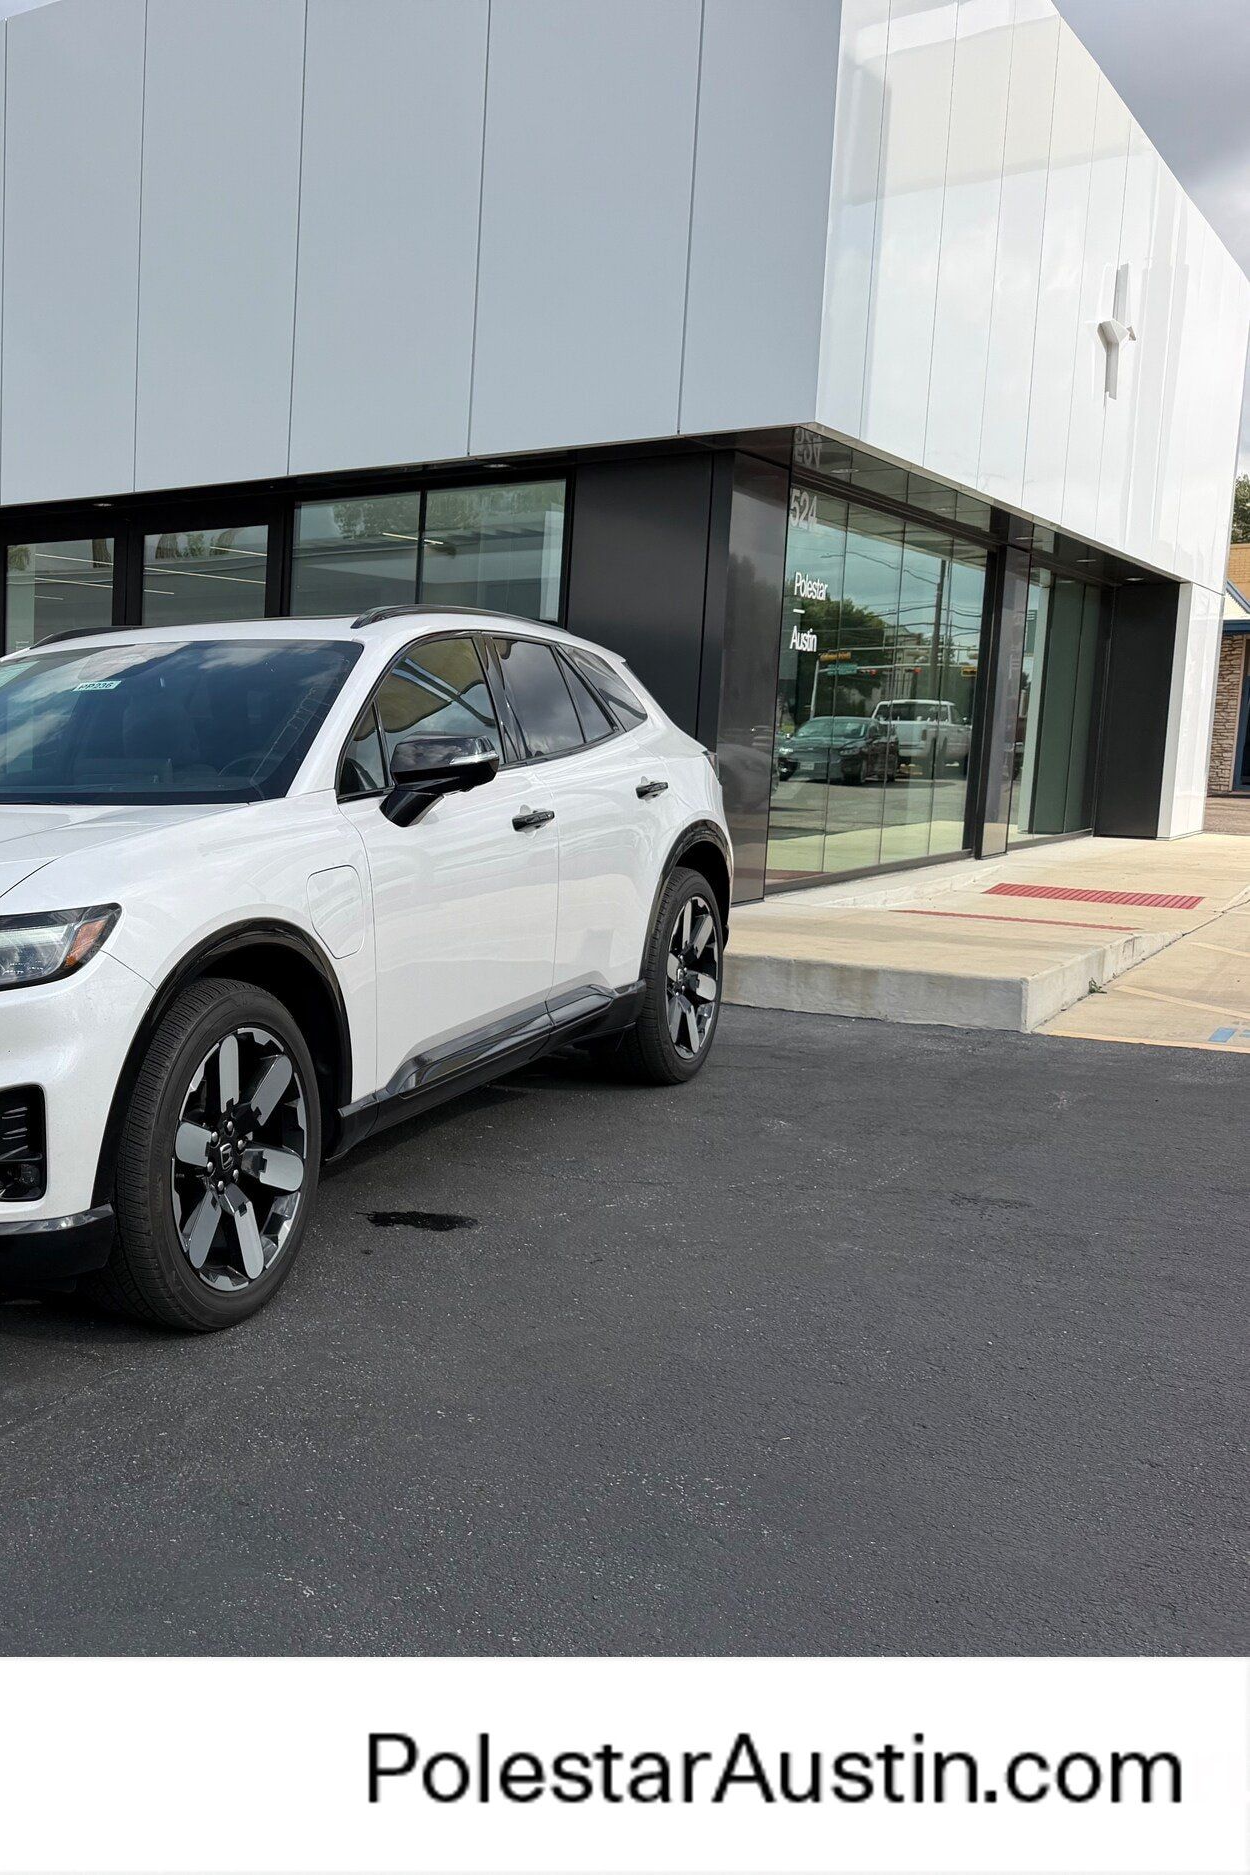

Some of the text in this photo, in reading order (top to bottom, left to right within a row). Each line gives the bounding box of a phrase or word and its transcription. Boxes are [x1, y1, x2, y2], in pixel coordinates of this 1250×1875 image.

[790, 489, 817, 531] 524
[794, 572, 828, 600] Polestar
[789, 625, 817, 652] Austin
